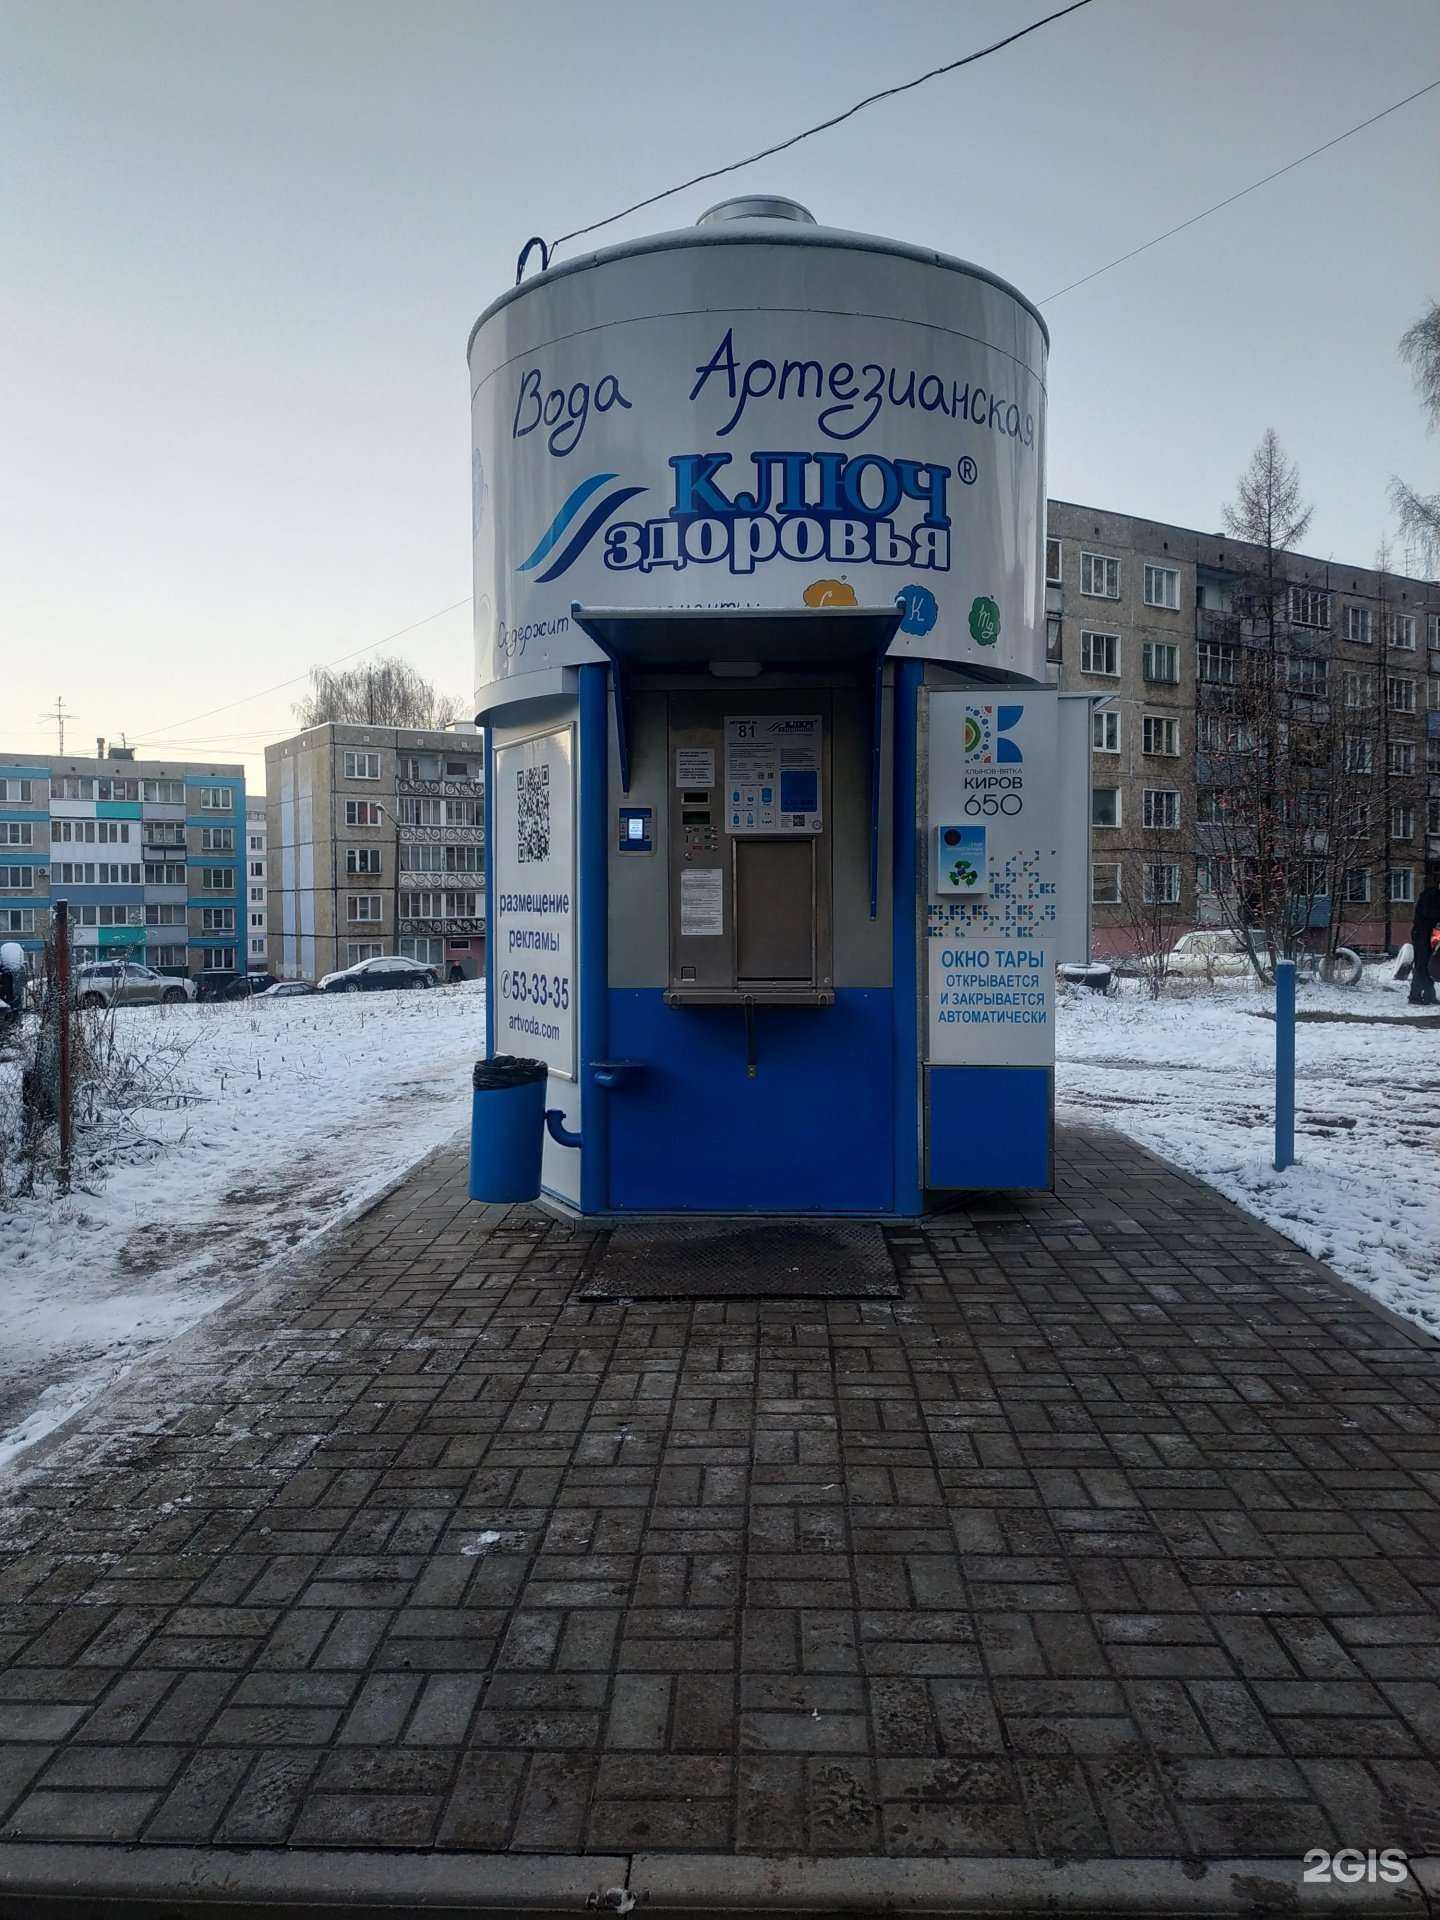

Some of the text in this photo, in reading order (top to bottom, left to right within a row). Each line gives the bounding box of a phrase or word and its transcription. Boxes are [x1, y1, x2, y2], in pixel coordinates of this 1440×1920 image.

[513, 327, 1034, 457] Вода Артезианская
[668, 450, 952, 529] КЛЮЧ
[603, 515, 951, 575] здоровья
[738, 724, 755, 738] 81
[964, 776, 1023, 790] КИРОВ
[964, 793, 1023, 816] 650
[499, 892, 569, 918] размещение
[508, 928, 560, 954] рекламы
[941, 950, 1044, 968] ОКНО ТАРЫ
[511, 970, 569, 1010] 53-33-35
[945, 974, 1040, 988] ОТКРЫВАЕТСЯ
[940, 992, 1045, 1006] И ЗАКРЫВАЕТСЯ
[508, 1011, 560, 1041] artvoda.com
[938, 1010, 1047, 1024] АВТОМАТИЧЕСКИ
